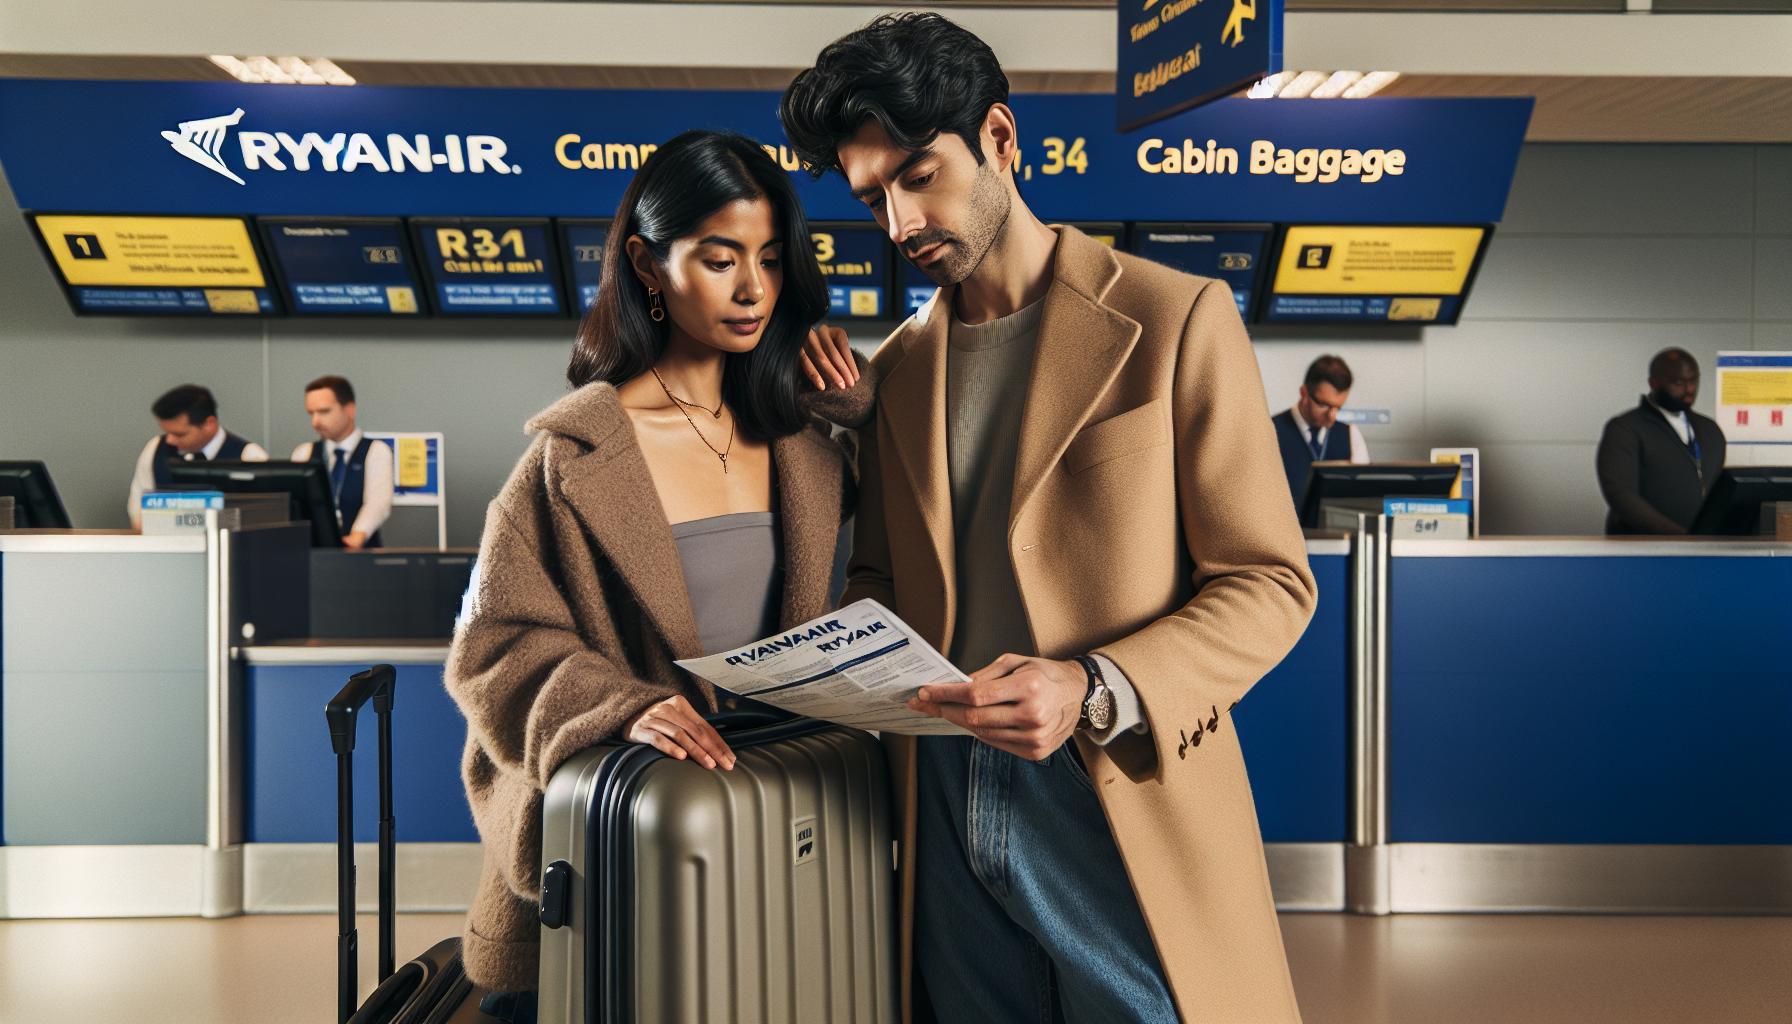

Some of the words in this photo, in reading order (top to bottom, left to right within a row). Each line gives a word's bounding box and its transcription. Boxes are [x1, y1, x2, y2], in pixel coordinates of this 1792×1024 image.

[1042, 136, 1088, 175] 34
[1137, 138, 1239, 175] Cabin
[1249, 139, 1407, 183] Baggage
